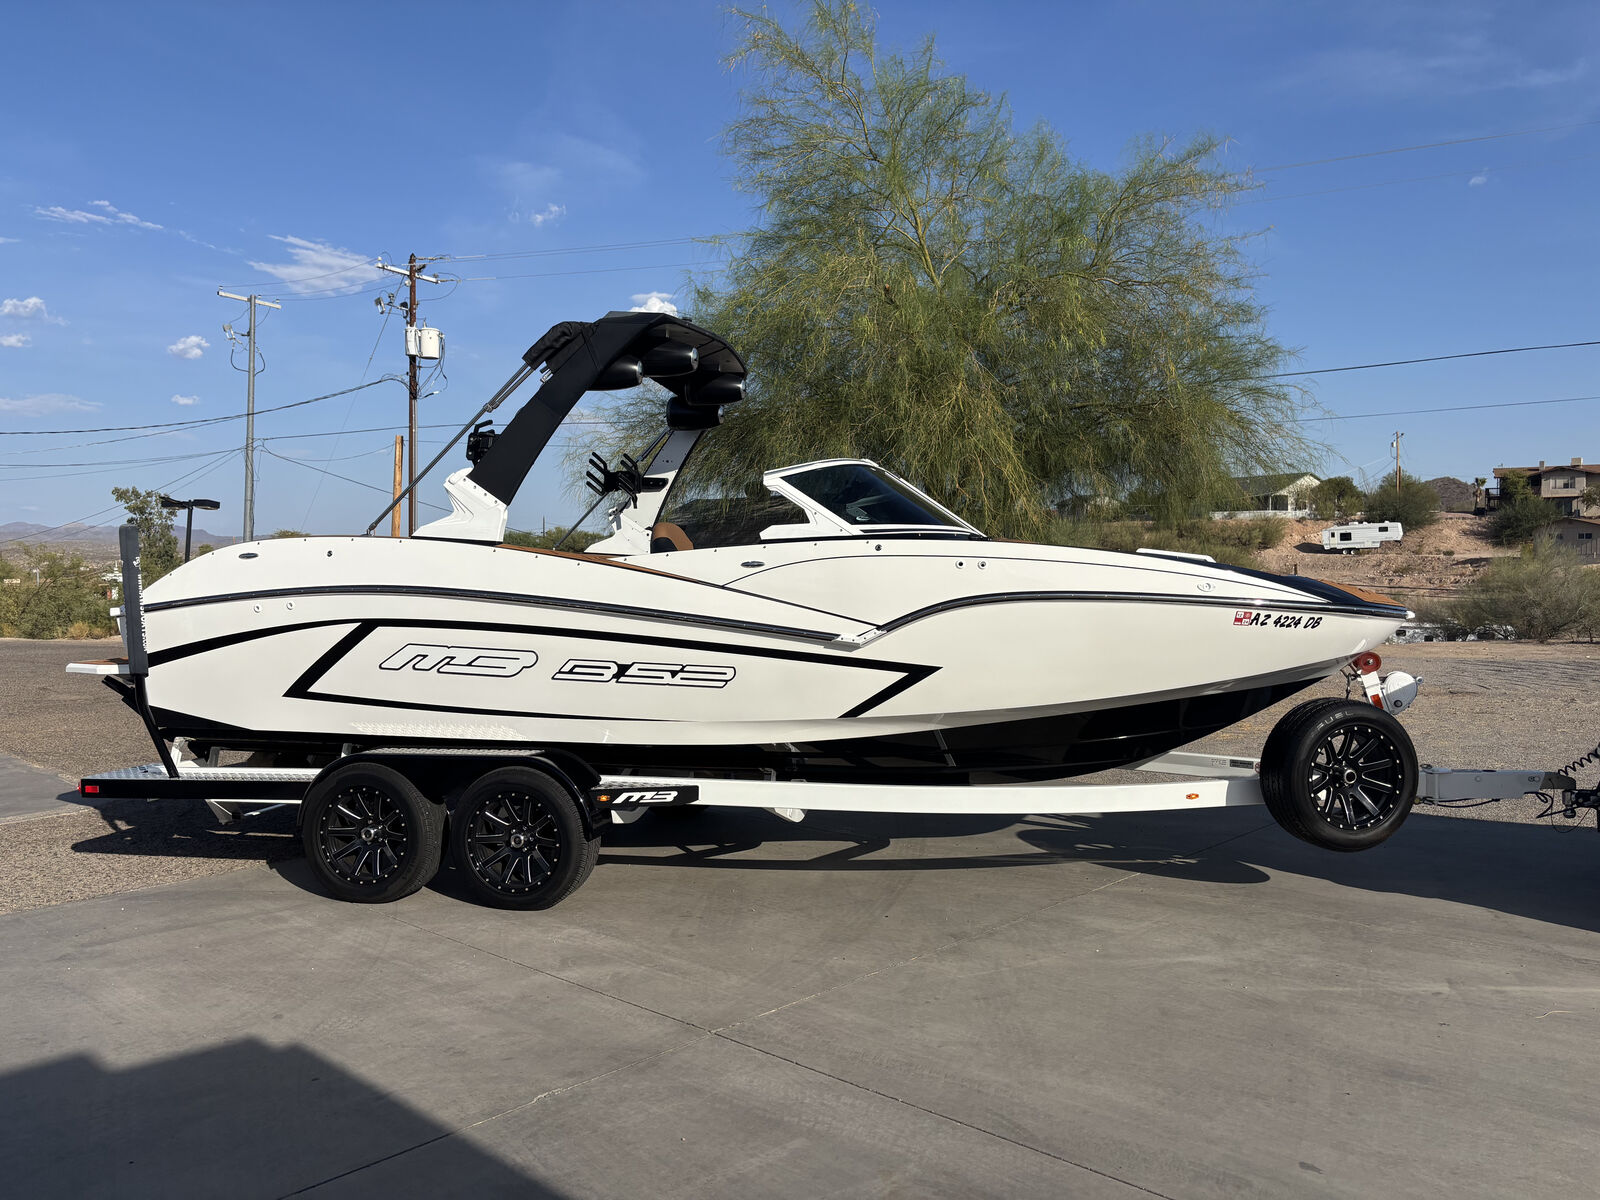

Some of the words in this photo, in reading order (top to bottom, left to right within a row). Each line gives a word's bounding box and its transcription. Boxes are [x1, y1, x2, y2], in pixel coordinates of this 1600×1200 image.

[1250, 612, 1272, 627] AZ
[1273, 614, 1303, 629] 4224
[1303, 616, 1323, 629] DB
[1316, 711, 1354, 731] FUEL
